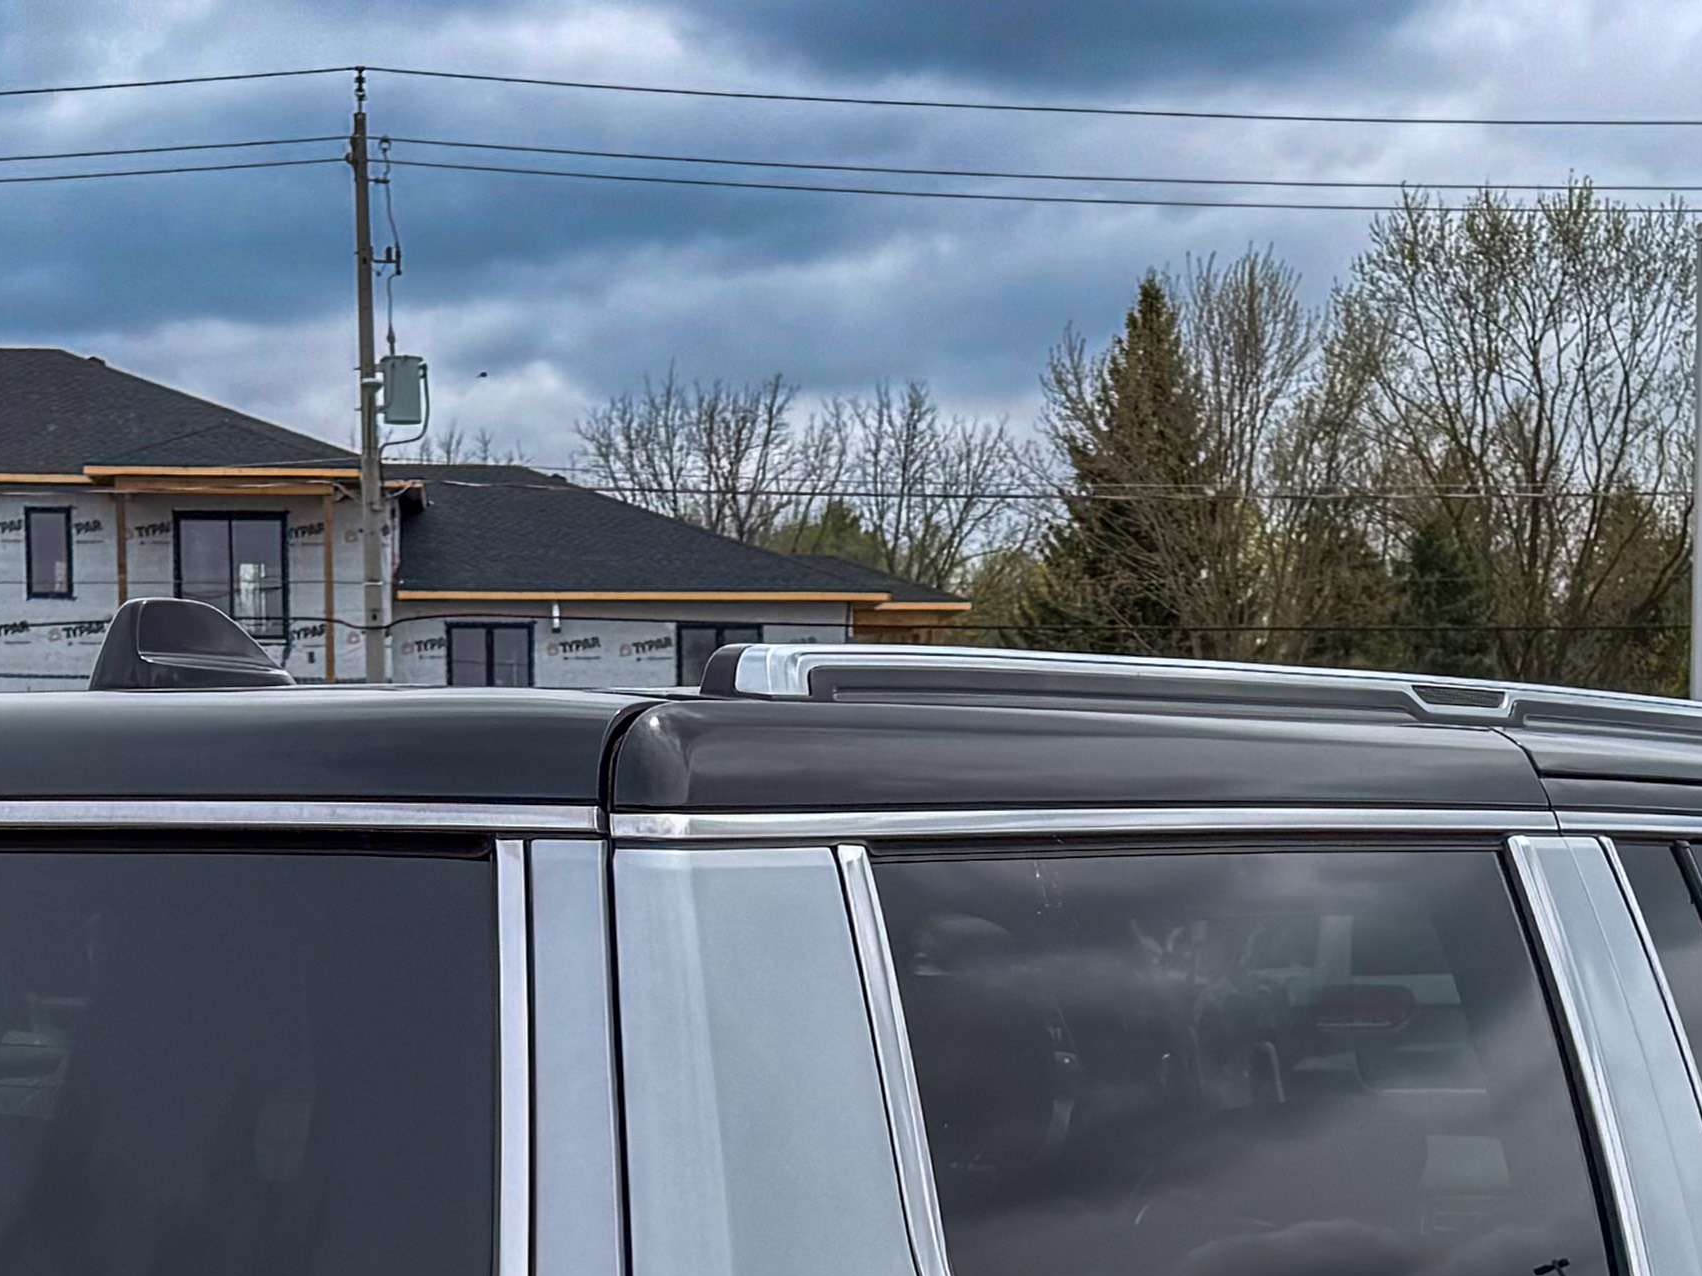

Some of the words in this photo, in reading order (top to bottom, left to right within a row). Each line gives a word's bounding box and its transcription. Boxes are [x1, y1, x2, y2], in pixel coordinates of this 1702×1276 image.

[74, 519, 102, 535] PAR
[559, 636, 601, 653] TYPAR
[631, 636, 672, 653] TYPAR
